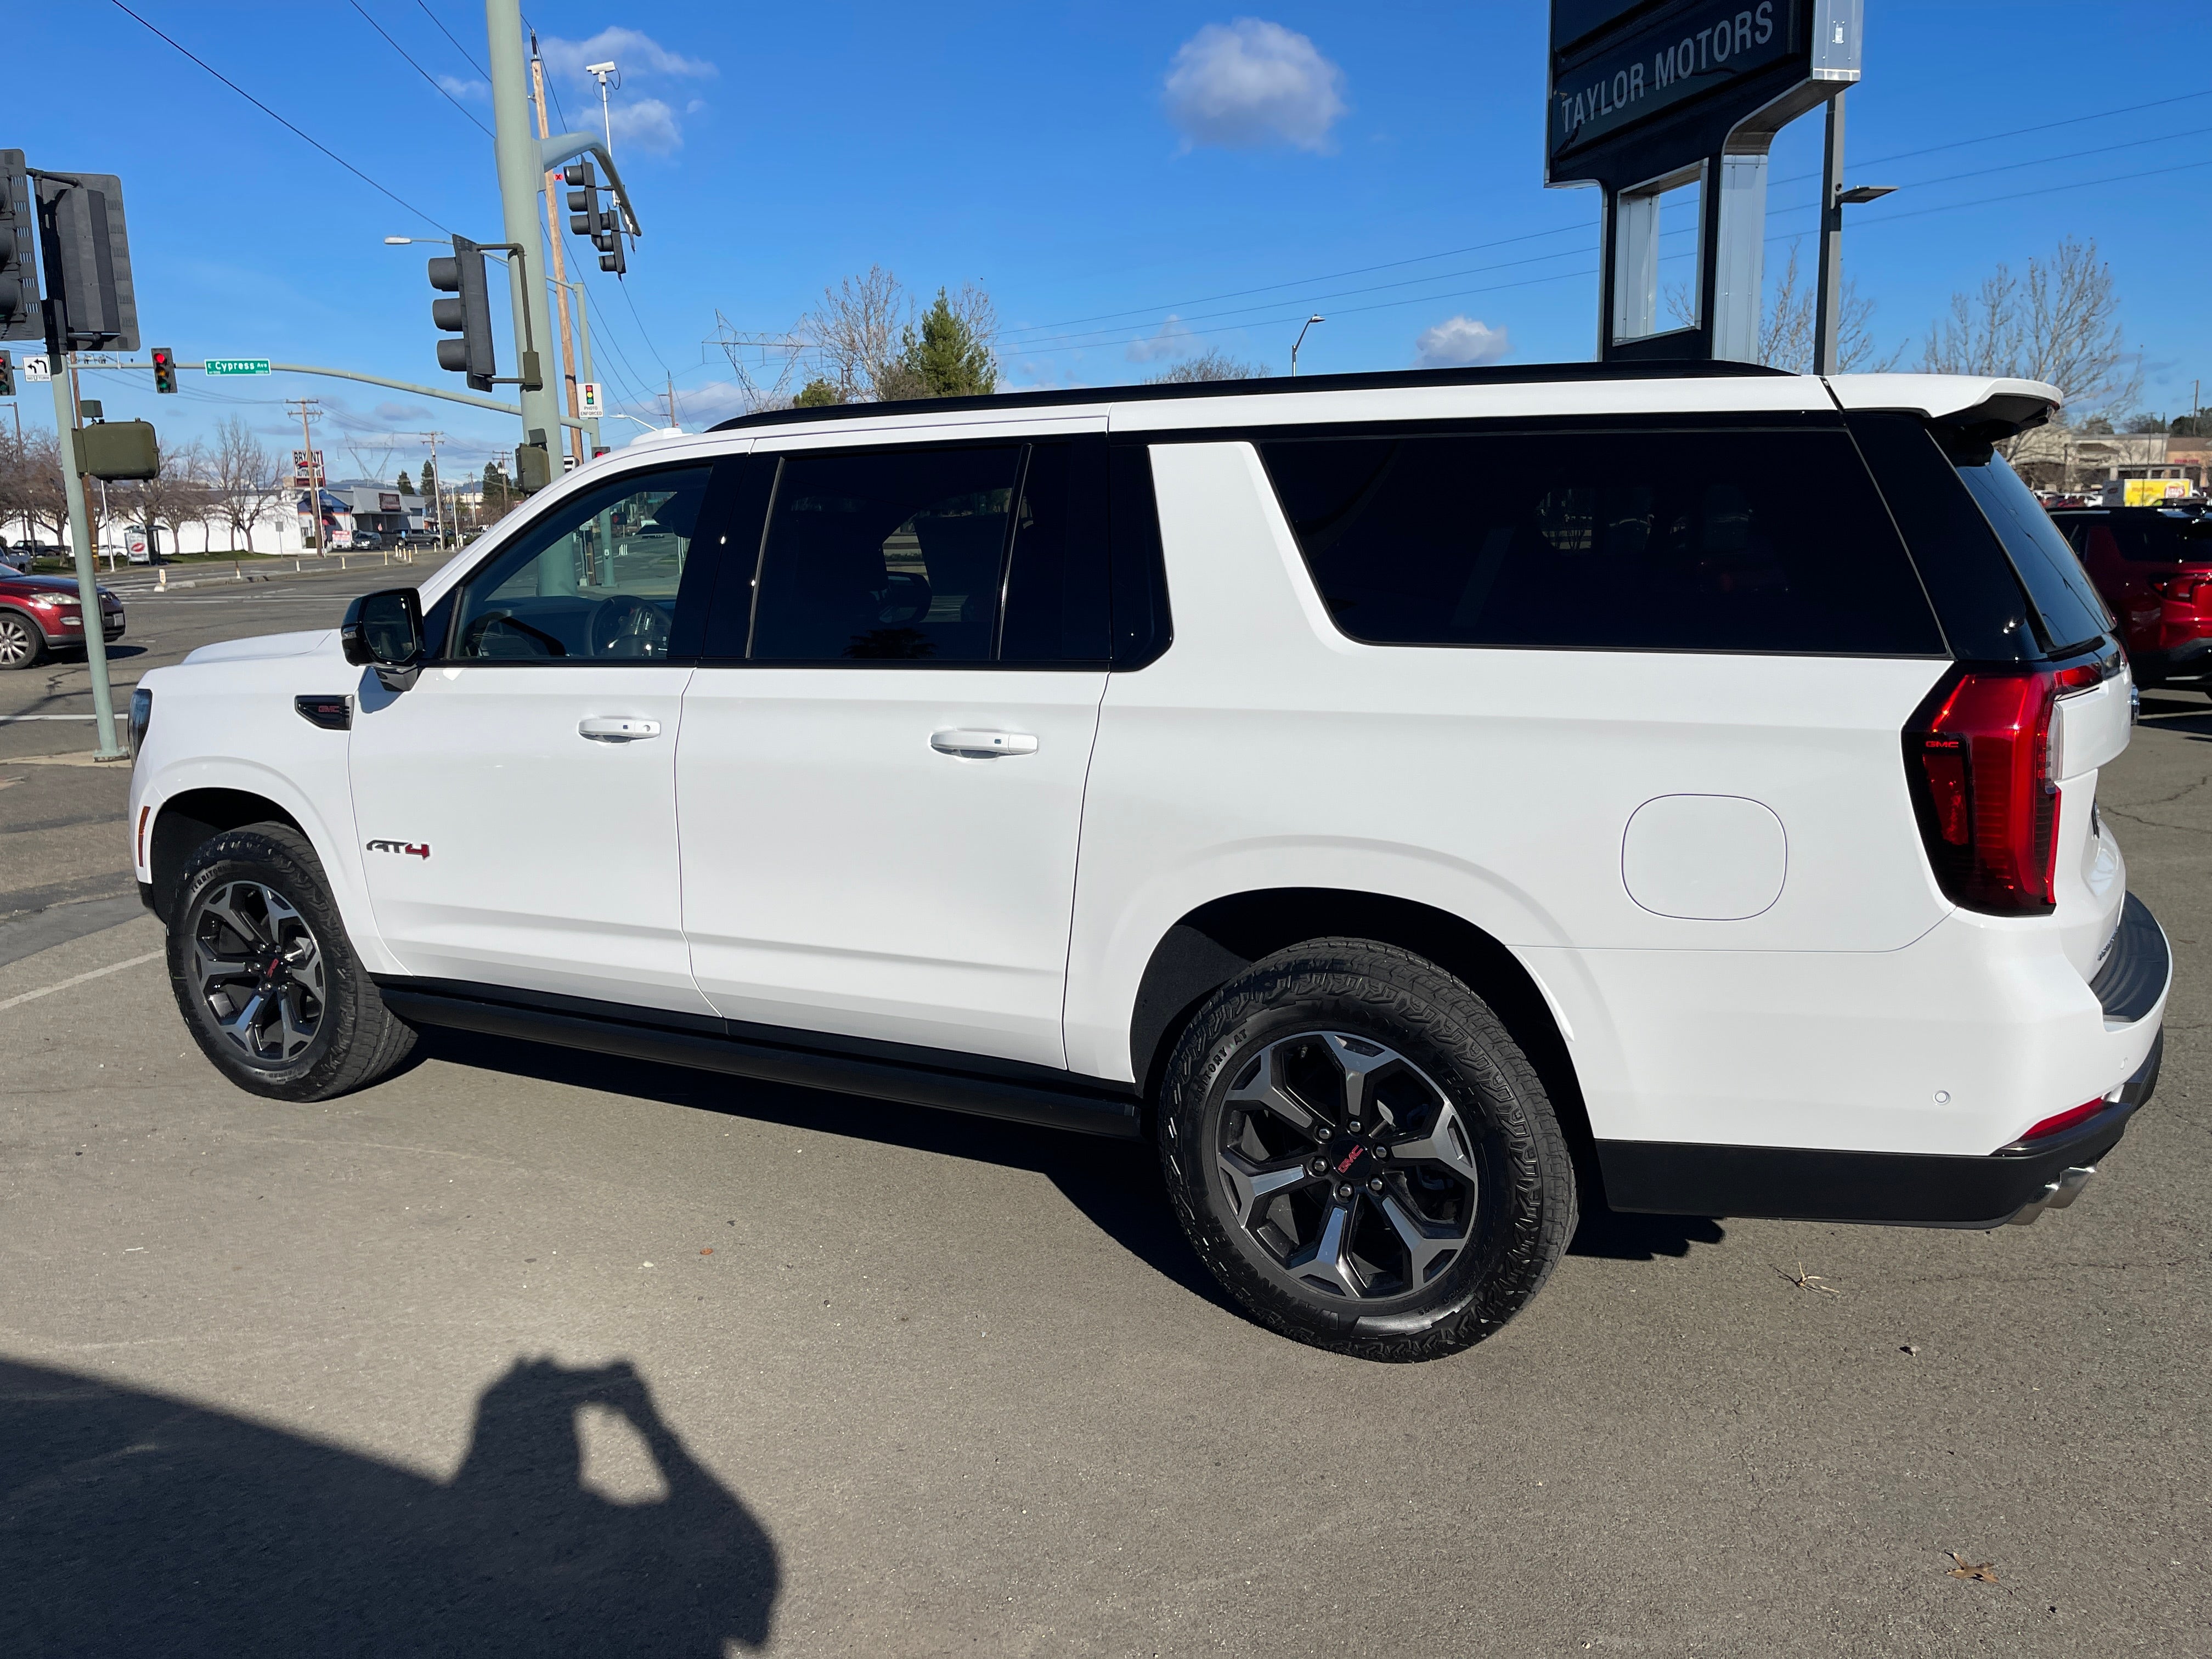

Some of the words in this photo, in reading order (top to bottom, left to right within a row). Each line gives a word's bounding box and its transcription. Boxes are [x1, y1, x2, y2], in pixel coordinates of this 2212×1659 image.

[1562, 62, 1645, 133] TAYLOR
[1655, 1, 1773, 91] MOTORS
[215, 362, 255, 373] Cypress
[294, 451, 320, 465] BRYNT
[1925, 740, 1959, 748] GMC
[366, 840, 430, 860] AT4
[1234, 1028, 1248, 1046] AT
[1338, 1144, 1364, 1173] GMC
